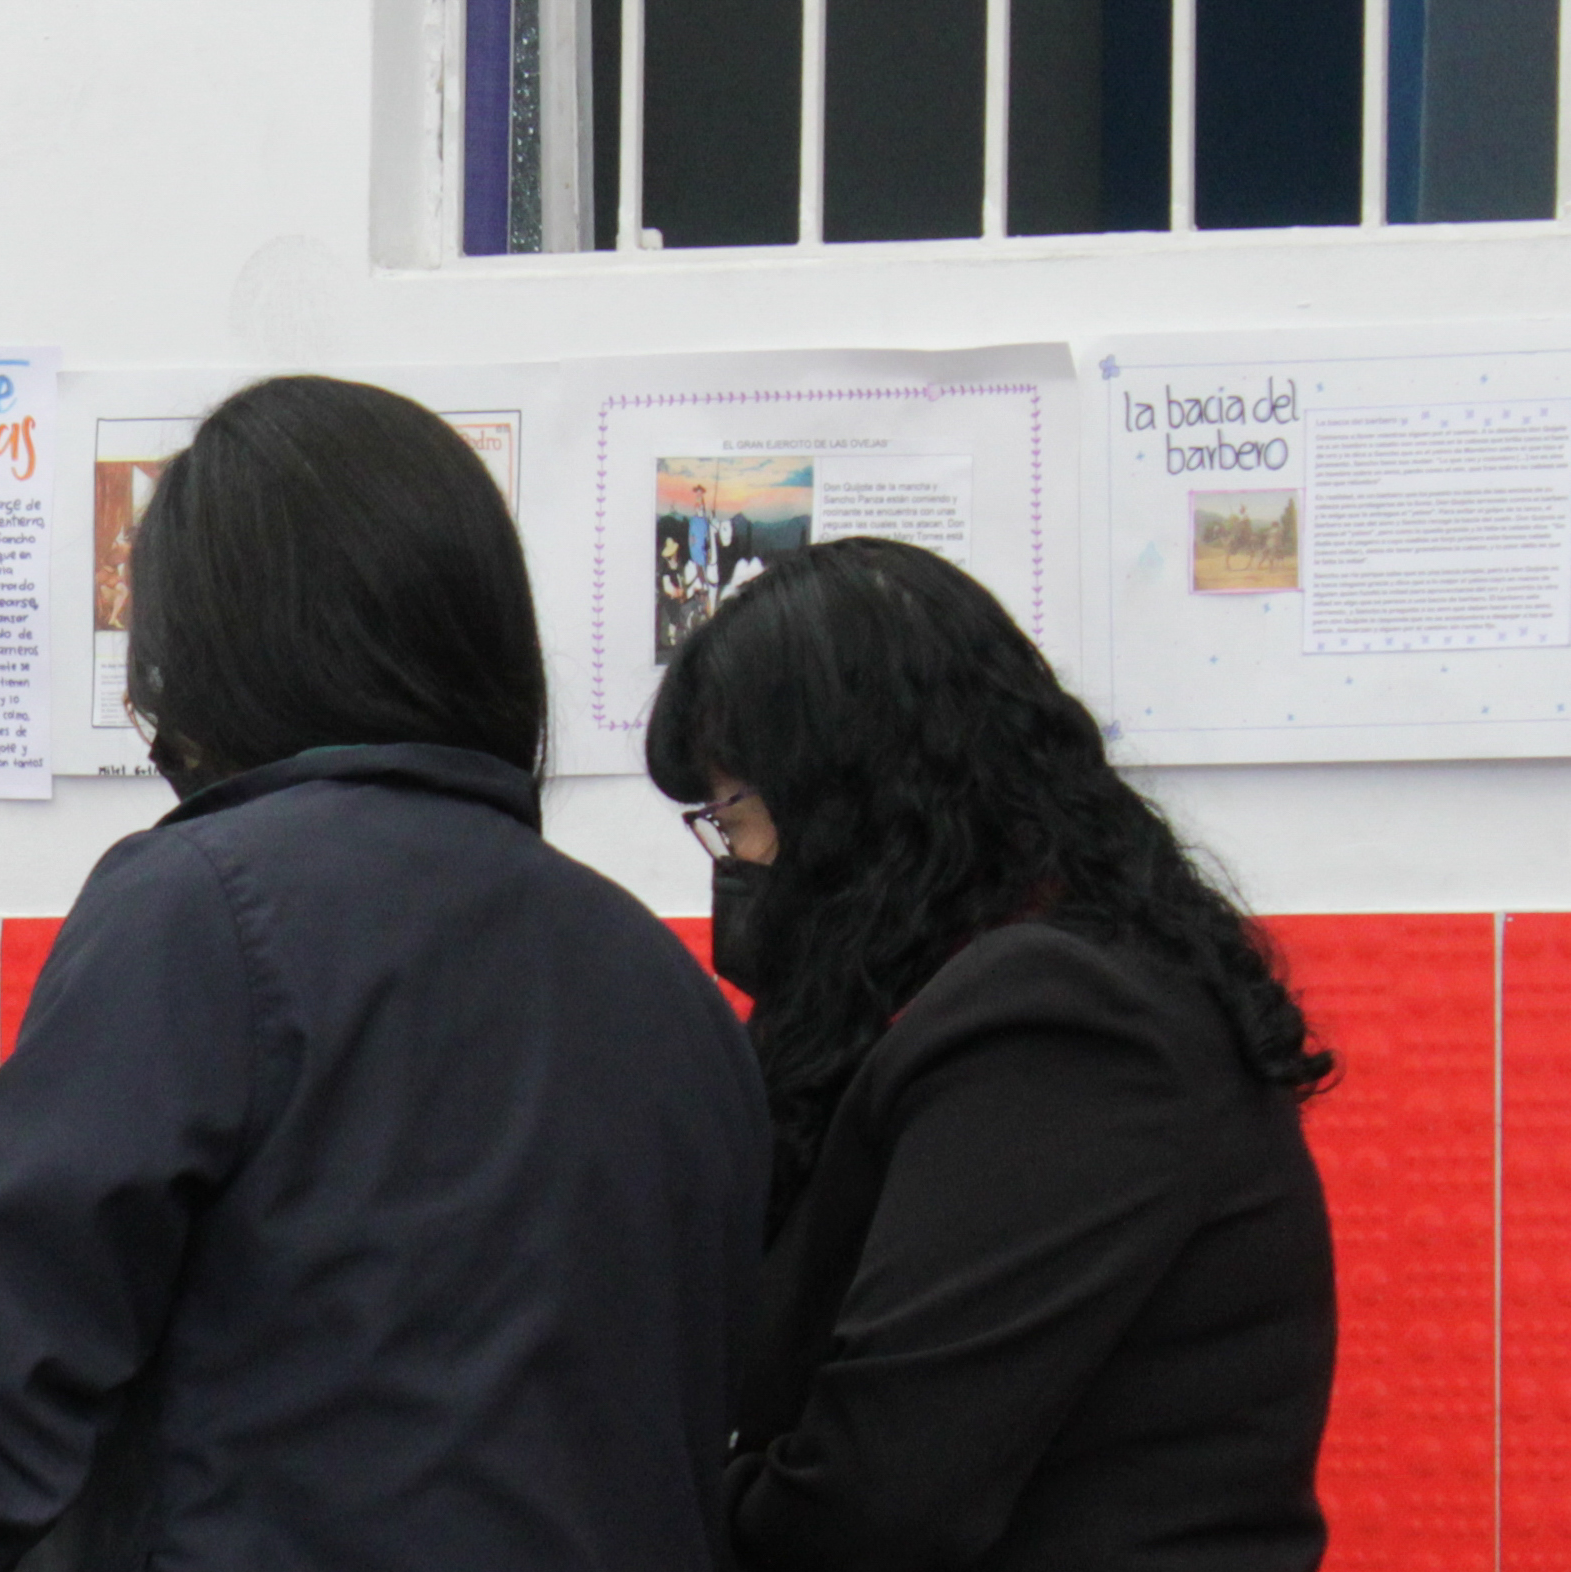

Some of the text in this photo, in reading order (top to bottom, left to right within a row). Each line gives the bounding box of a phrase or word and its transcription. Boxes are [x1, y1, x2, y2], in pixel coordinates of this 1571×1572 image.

[1124, 391, 1156, 432] la
[1252, 376, 1300, 424] del
[723, 441, 734, 450] EL
[737, 440, 764, 450] GRAN
[766, 440, 811, 449] EJERCITO
[815, 440, 826, 449] DE
[829, 439, 847, 449] LAS
[1166, 428, 1288, 475] barbero
[823, 482, 841, 492] Don
[844, 482, 873, 494] Quijote
[875, 482, 886, 491] de
[889, 482, 896, 491] la
[898, 482, 930, 491] mancha
[26, 499, 41, 511] de
[823, 495, 856, 504] Sancho
[858, 495, 884, 504] Panza
[19, 551, 32, 560] en
[18, 628, 33, 640] de
[21, 661, 30, 671] se
